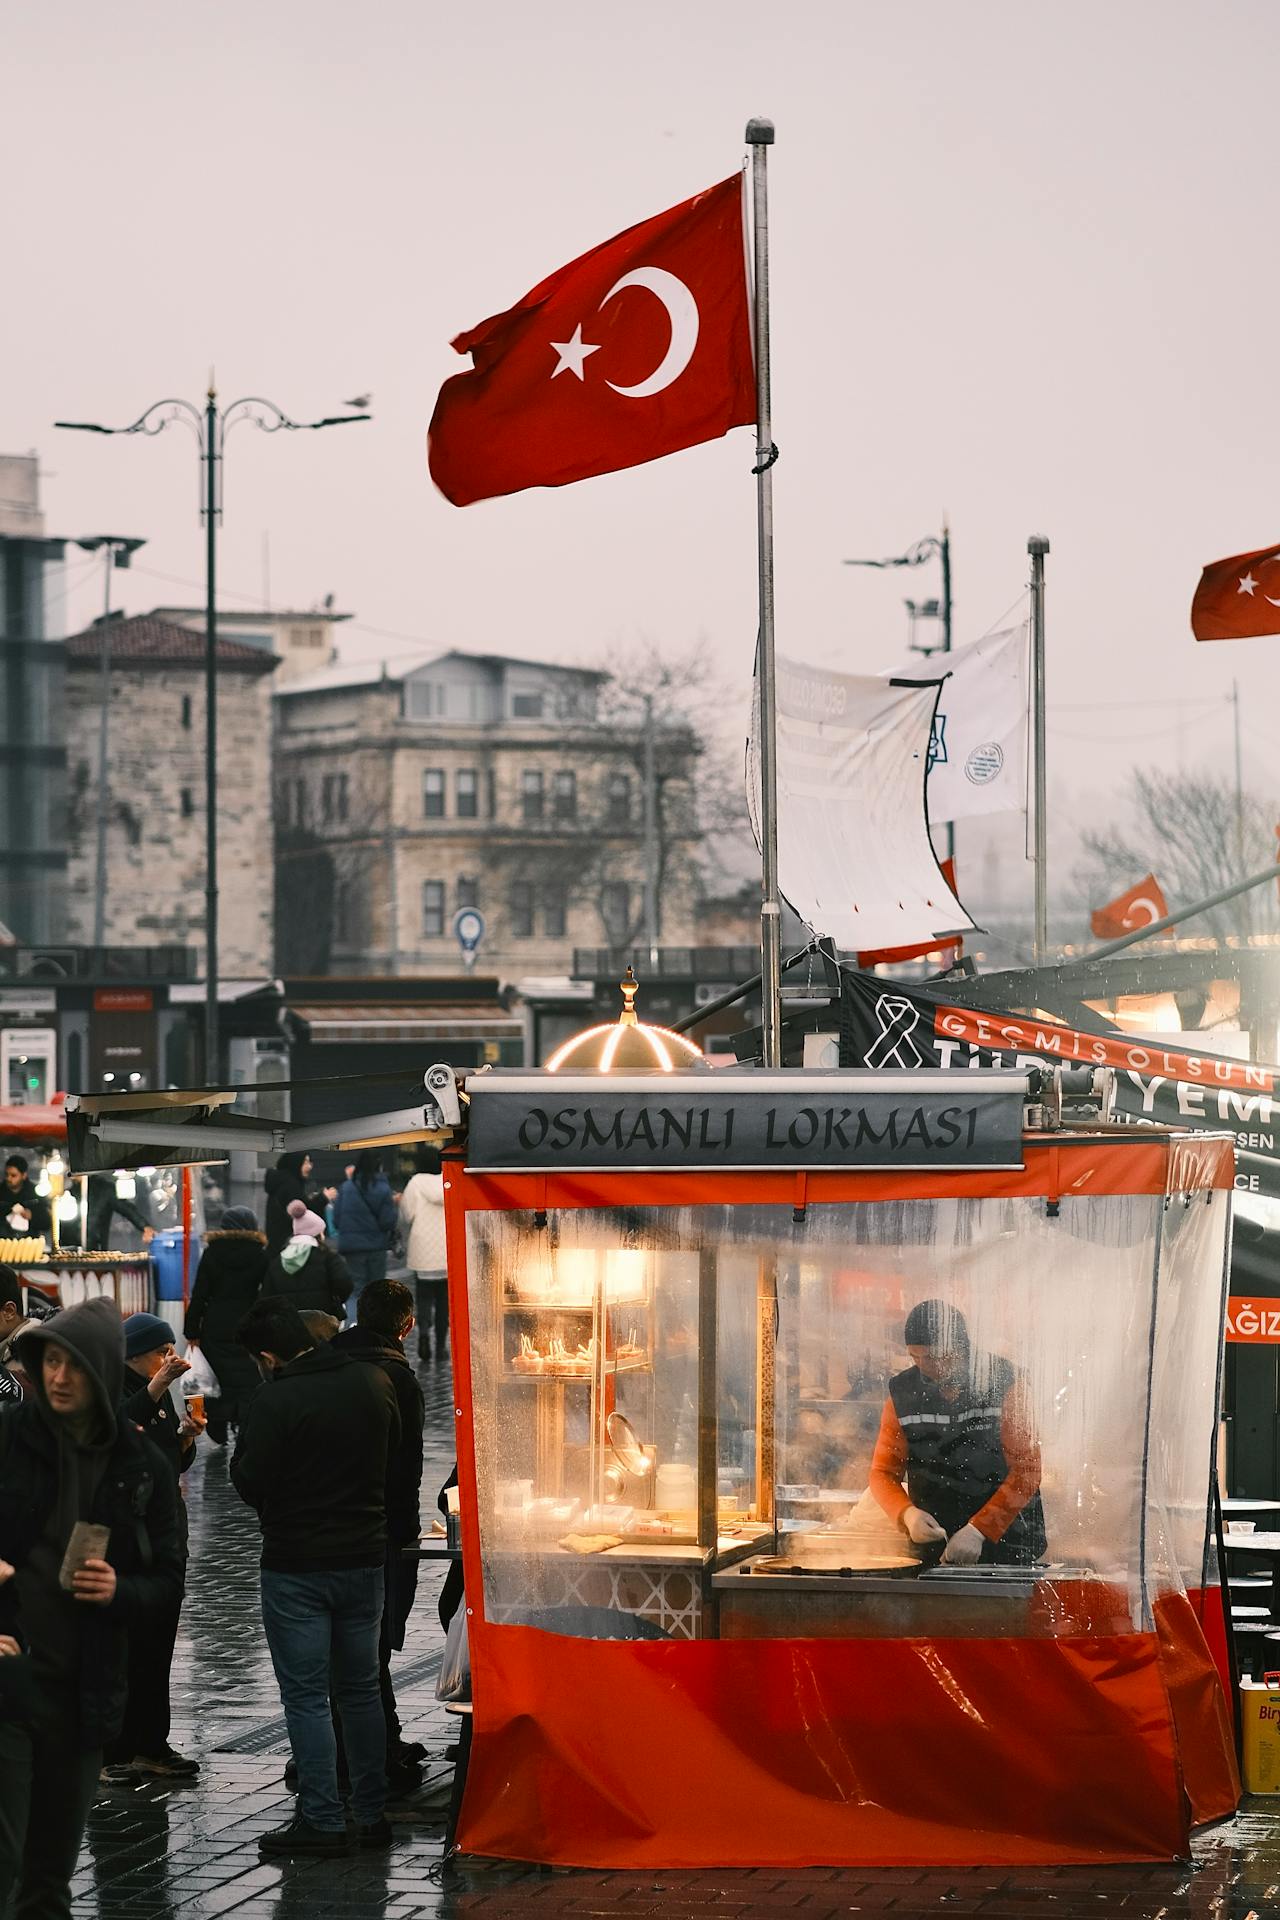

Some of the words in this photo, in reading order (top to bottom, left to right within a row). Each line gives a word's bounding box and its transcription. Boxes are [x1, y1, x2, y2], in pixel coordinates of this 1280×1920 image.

[933, 1039, 1273, 1124] TÜYEM
[942, 1014, 1107, 1066] GEÇMİŞ
[1127, 1048, 1267, 1086] OLSUN
[518, 1107, 734, 1151] OSMANLI
[764, 1107, 977, 1151] LOKMASI
